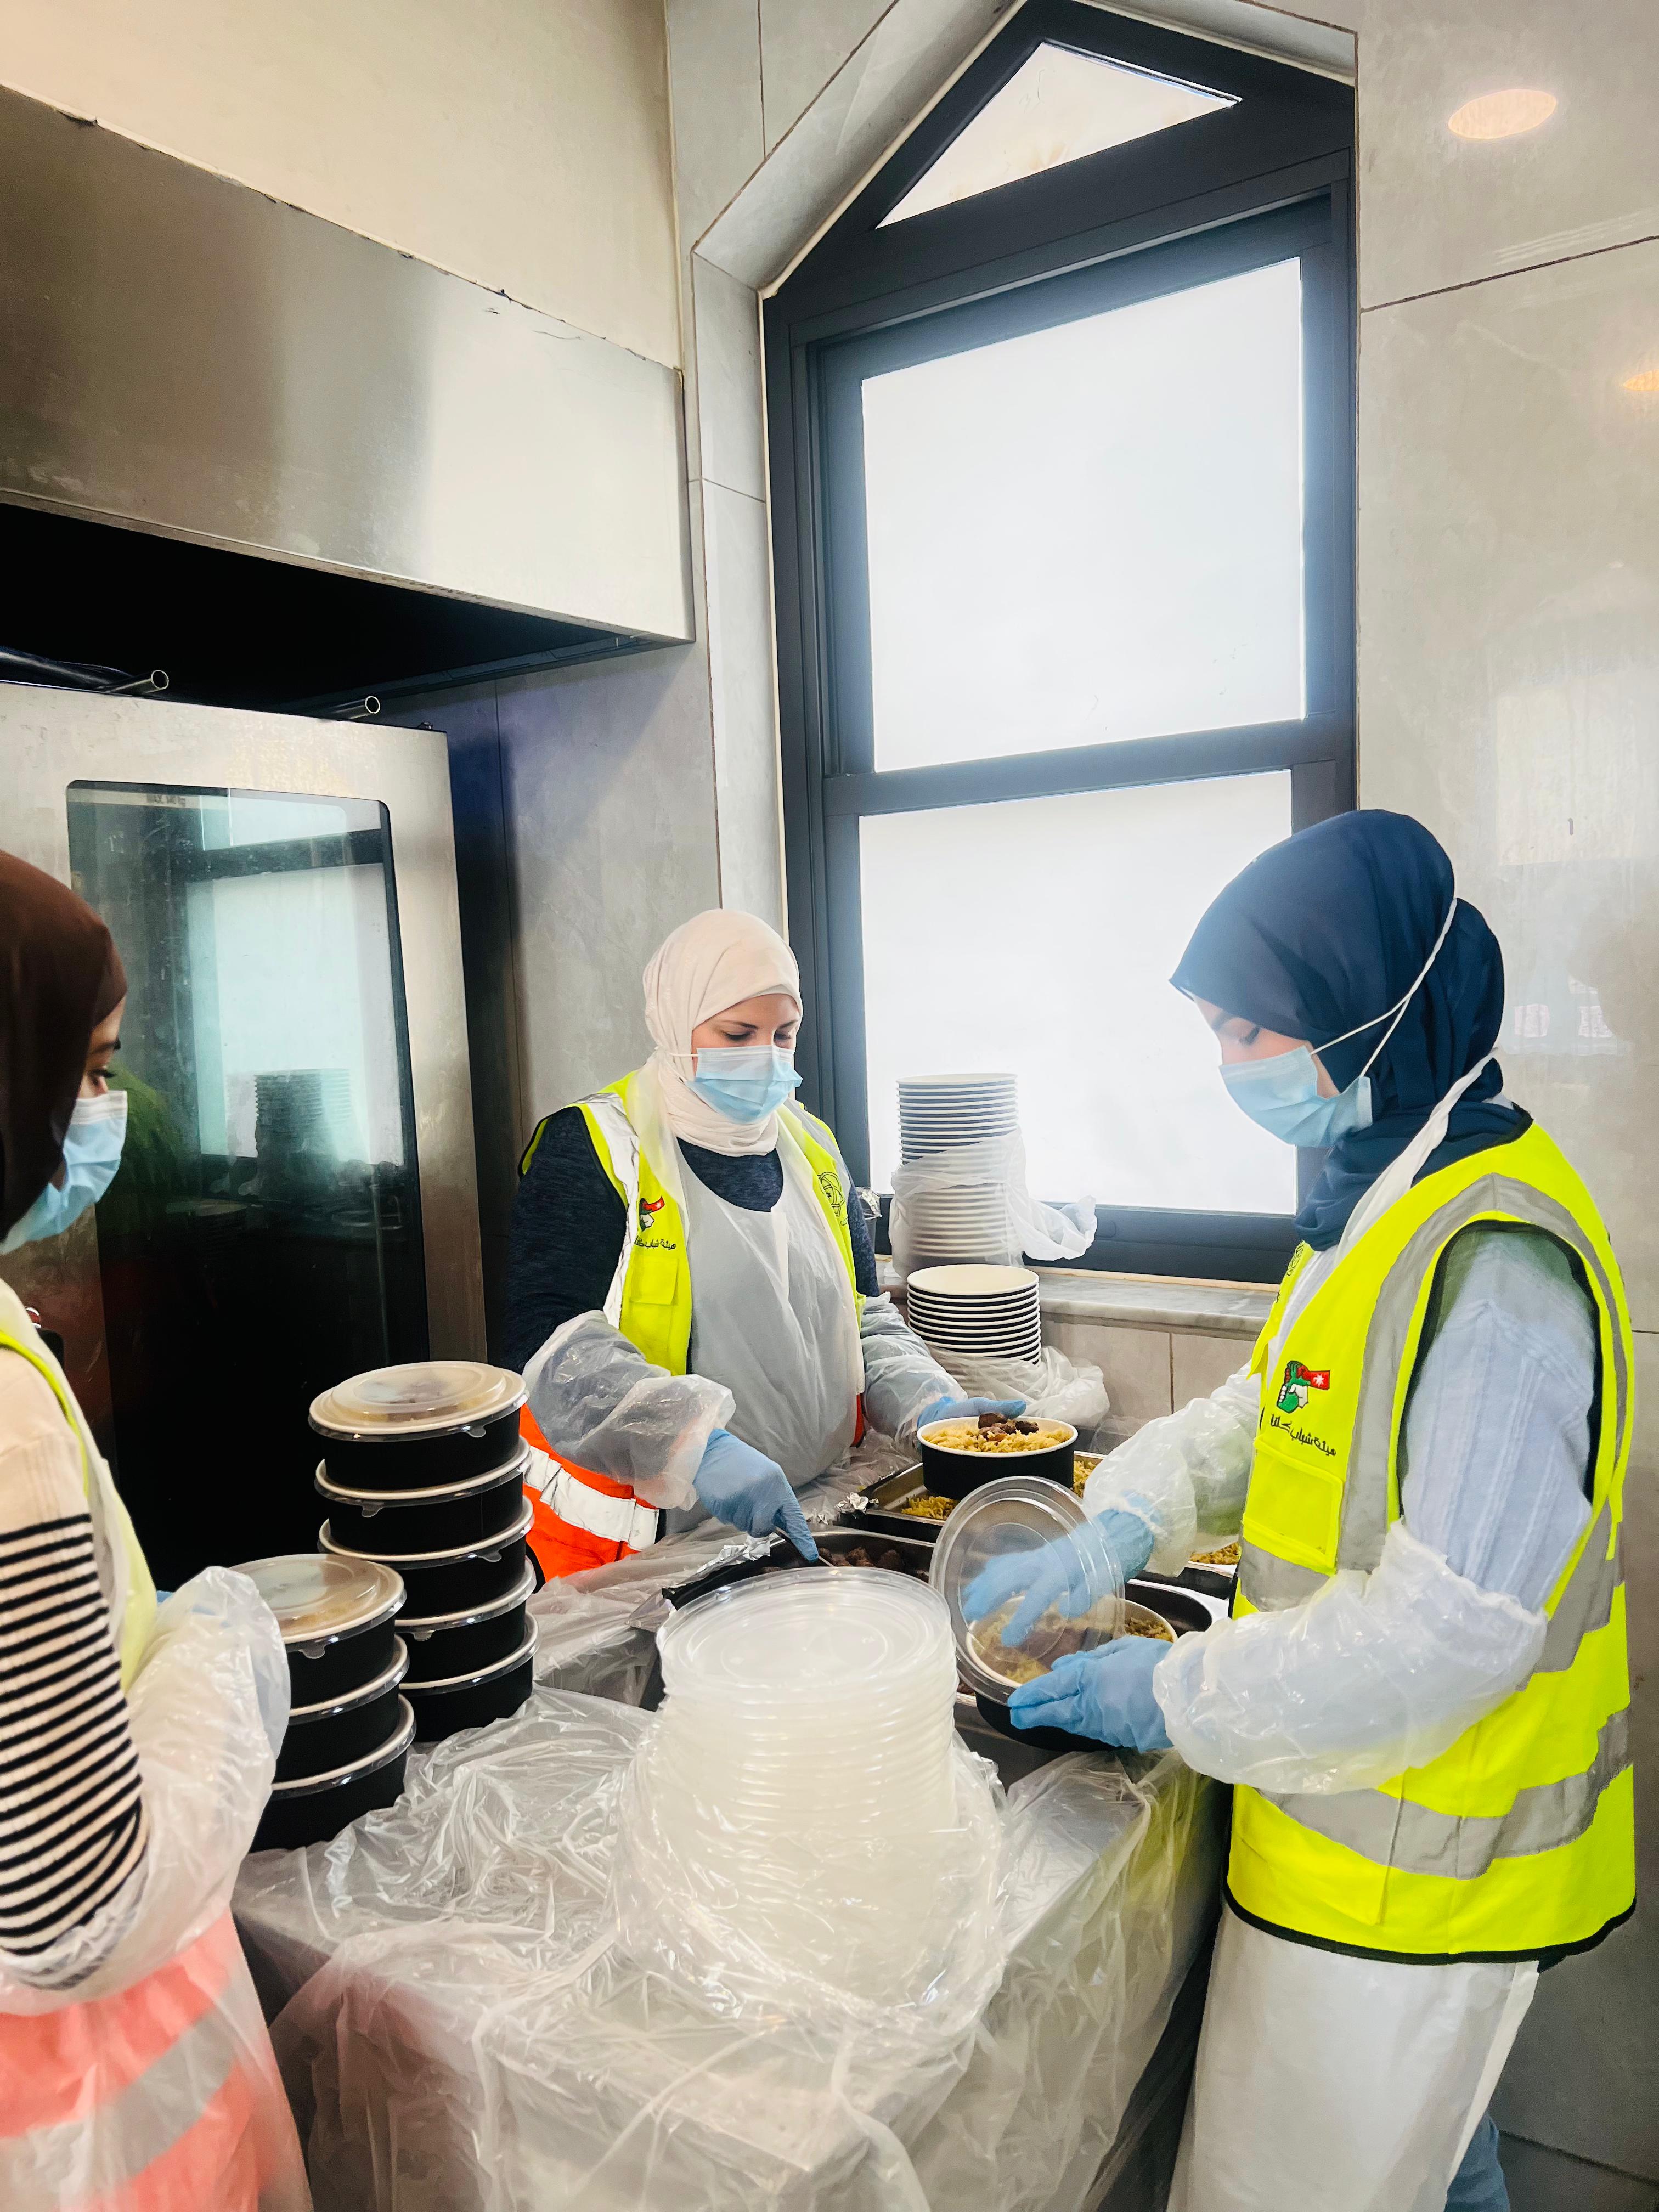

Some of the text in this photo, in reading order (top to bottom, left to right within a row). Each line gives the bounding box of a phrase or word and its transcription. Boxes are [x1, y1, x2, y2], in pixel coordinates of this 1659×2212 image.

[1270, 1413, 1336, 1456] هيئة شباب كلنا
